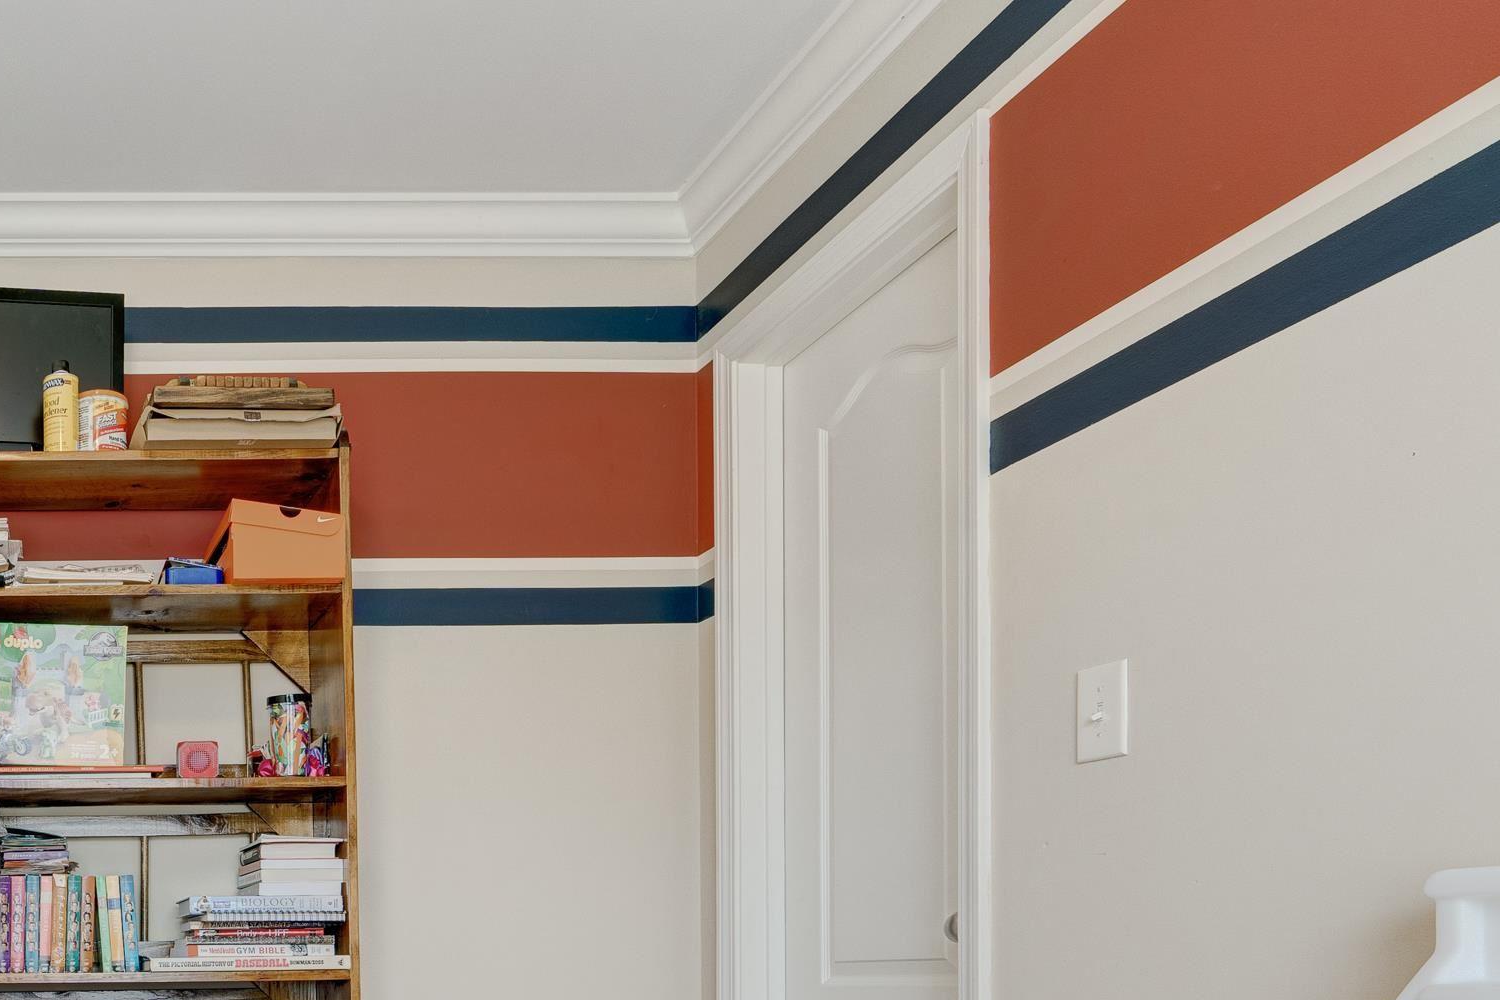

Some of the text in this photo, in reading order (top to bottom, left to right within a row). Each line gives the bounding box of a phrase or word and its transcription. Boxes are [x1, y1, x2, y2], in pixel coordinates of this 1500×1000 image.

[3, 634, 43, 651] duplo
[241, 898, 295, 907] BIOLOGY
[236, 946, 256, 954] GYM
[258, 946, 286, 954] BIBLE
[234, 959, 290, 968] BASEBALL
